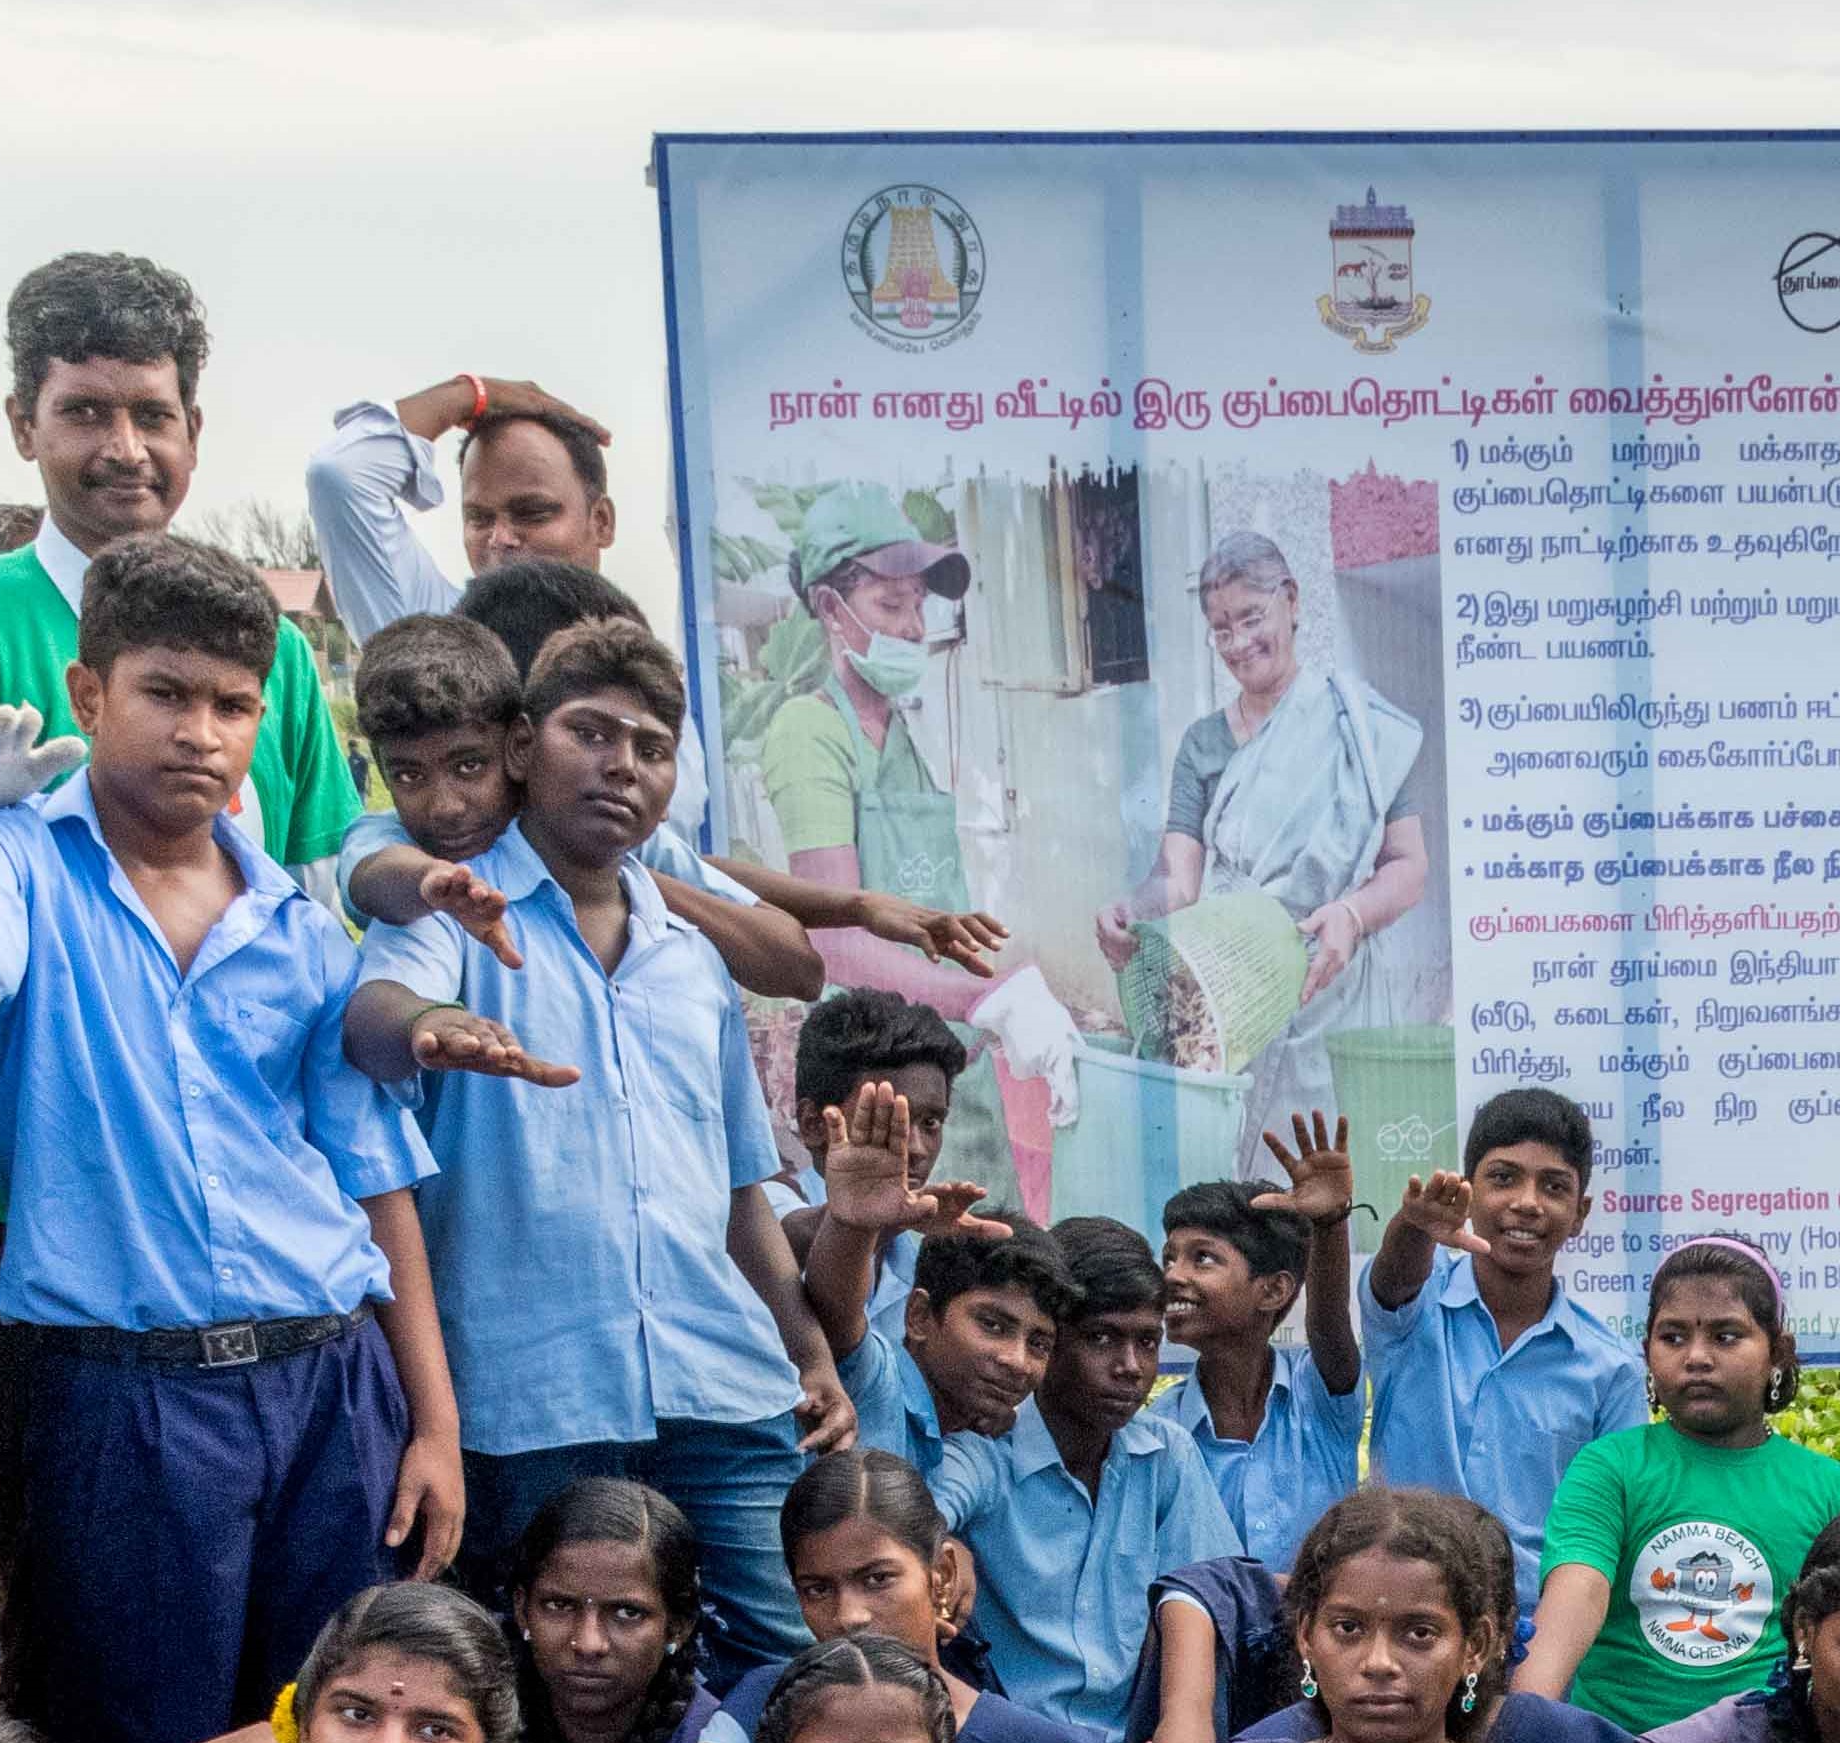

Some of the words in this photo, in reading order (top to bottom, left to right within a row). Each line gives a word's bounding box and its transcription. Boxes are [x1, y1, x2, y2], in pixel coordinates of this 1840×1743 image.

[769, 380, 860, 430] நான்
[873, 391, 984, 430] எனது
[996, 378, 1123, 430] வீட்டில்
[1133, 379, 1210, 430] இரு
[1223, 376, 1558, 429] குப்பைதொட்டிகள்
[1480, 435, 1573, 471] மக்கும்
[1612, 434, 1700, 470] மற்றும்
[1453, 476, 1723, 514] குப்பைதொட்டிகளை
[1454, 535, 1533, 564] எனது
[1541, 524, 1698, 564] நாட்டிற்காக
[1691, 587, 1777, 625] மற்றும்
[1456, 632, 1536, 669] நீண்ட
[1547, 630, 1655, 661] பயணம்.
[1719, 692, 1797, 721] பணம்
[1487, 740, 1649, 778] அனைவரும்
[1482, 803, 1573, 839] மக்கும்
[1584, 801, 1754, 838] குப்பைக்காக
[1483, 850, 1584, 885] மக்காத
[1594, 849, 1765, 886] குப்பைக்காக
[1774, 850, 1815, 884] நீல
[1469, 905, 1635, 941] குப்பைகளை
[1533, 952, 1598, 987] நான்
[1611, 950, 1717, 987] தூய்மை
[1731, 949, 1840, 986] இந்தியா
[1600, 1046, 1689, 1081] மக்கும்
[1641, 1093, 1684, 1128] நீல
[1714, 1093, 1758, 1127] நிற
[1603, 1189, 1683, 1213] Source
[1691, 1187, 1832, 1217] Segregation
[1622, 1232, 1642, 1253] to
[1760, 1231, 1792, 1255] my
[1573, 1270, 1634, 1293] Green
[1800, 1268, 1817, 1289] in
[1650, 1524, 1711, 1555] NAMMA
[1714, 1527, 1763, 1571] BEACH
[1647, 1618, 1687, 1658] NAMMA
[1688, 1631, 1752, 1660] CHENNAI
